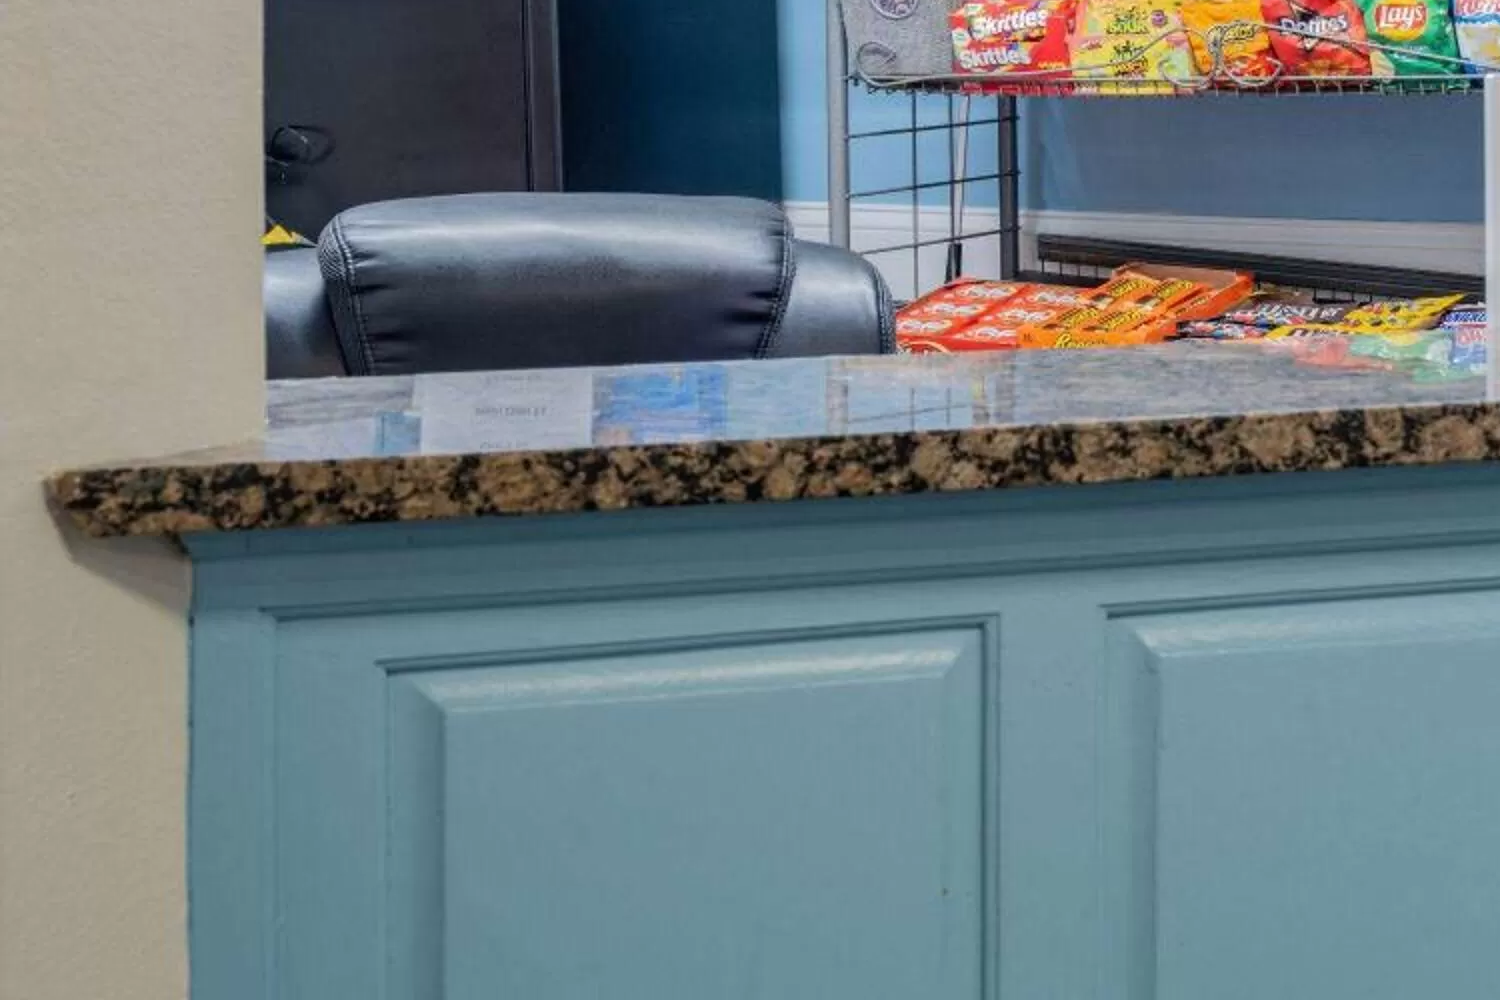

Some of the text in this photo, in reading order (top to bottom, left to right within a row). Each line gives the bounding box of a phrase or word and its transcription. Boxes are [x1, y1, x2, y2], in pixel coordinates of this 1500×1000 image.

[972, 9, 1049, 40] Skittles
[1279, 13, 1348, 37] Doritos
[1379, 3, 1424, 28] Lay's
[958, 45, 1032, 69] Skittles
